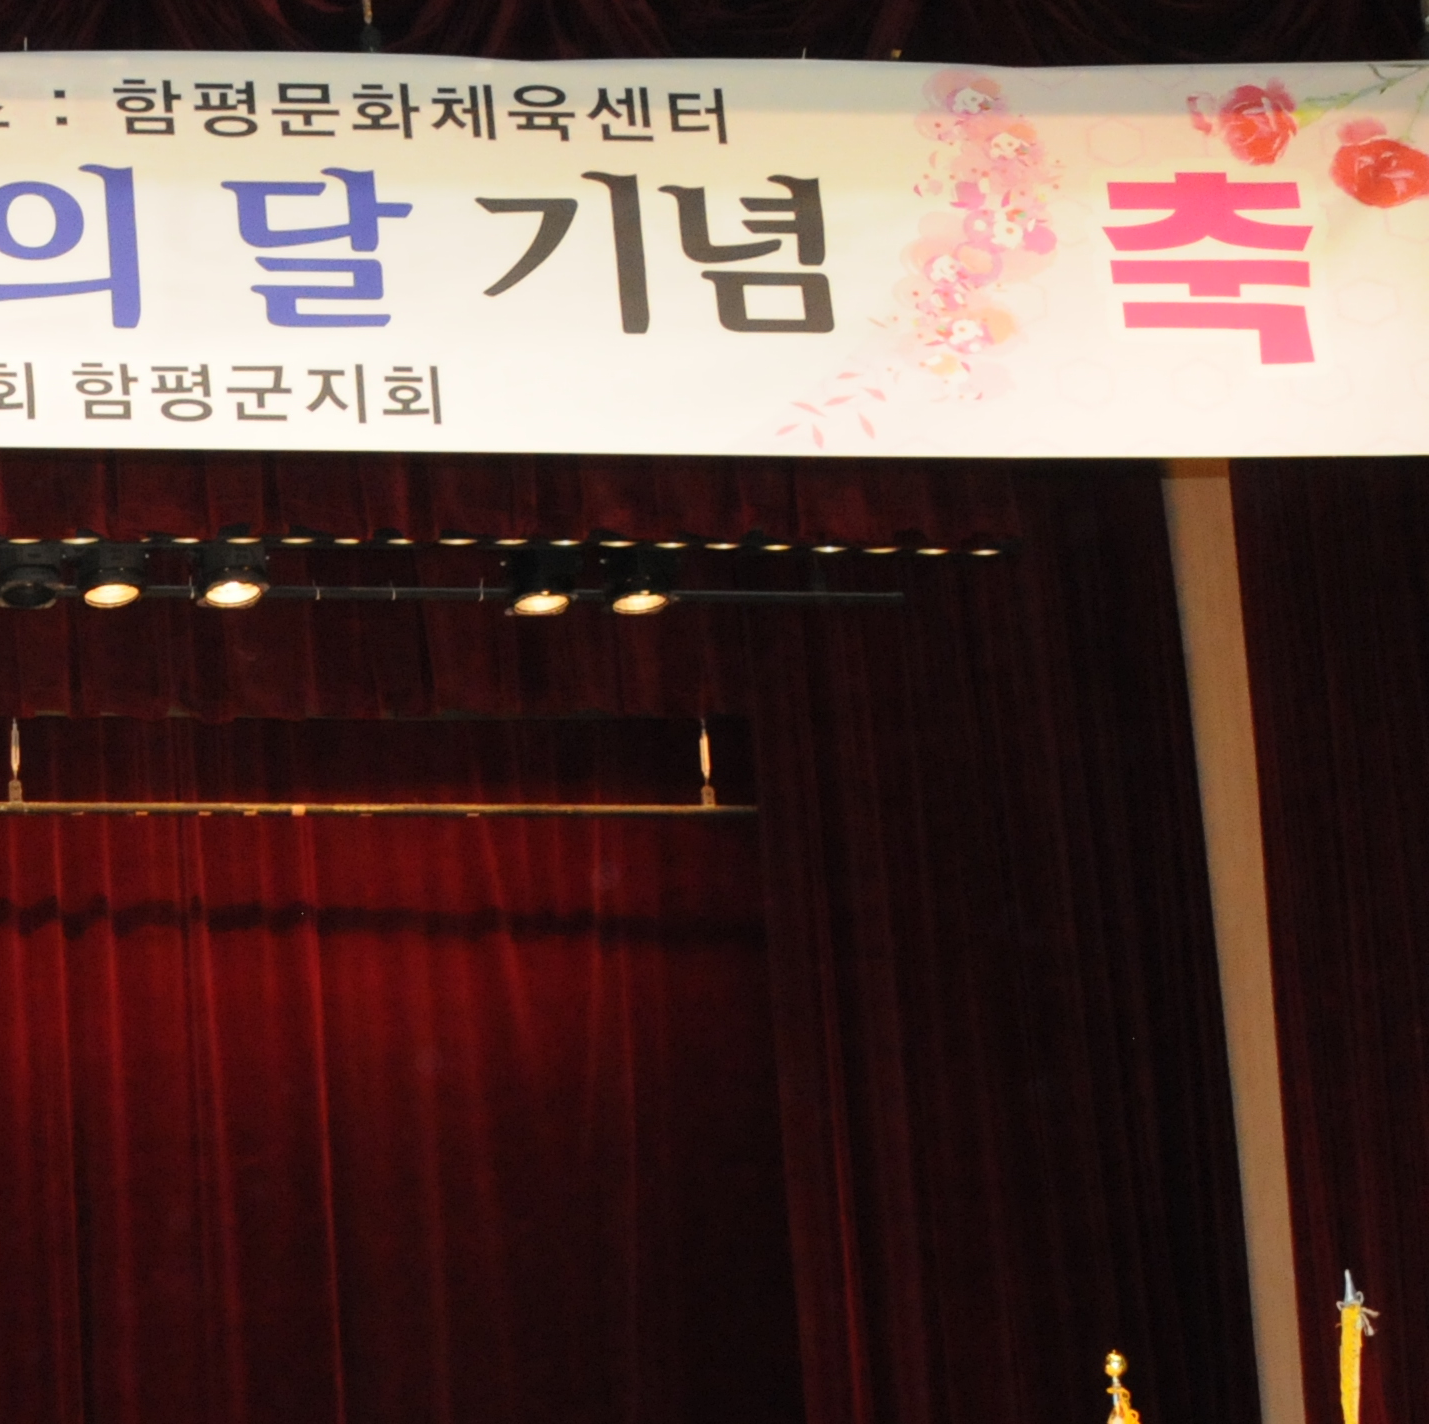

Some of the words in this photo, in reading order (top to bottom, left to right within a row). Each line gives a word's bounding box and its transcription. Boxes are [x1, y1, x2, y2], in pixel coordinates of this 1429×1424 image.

[112, 78, 727, 144] 함평문화체육센터
[224, 169, 412, 327] 달
[475, 171, 835, 334] 기념
[1103, 171, 1315, 365] 축
[73, 363, 442, 424] 함평군지회
